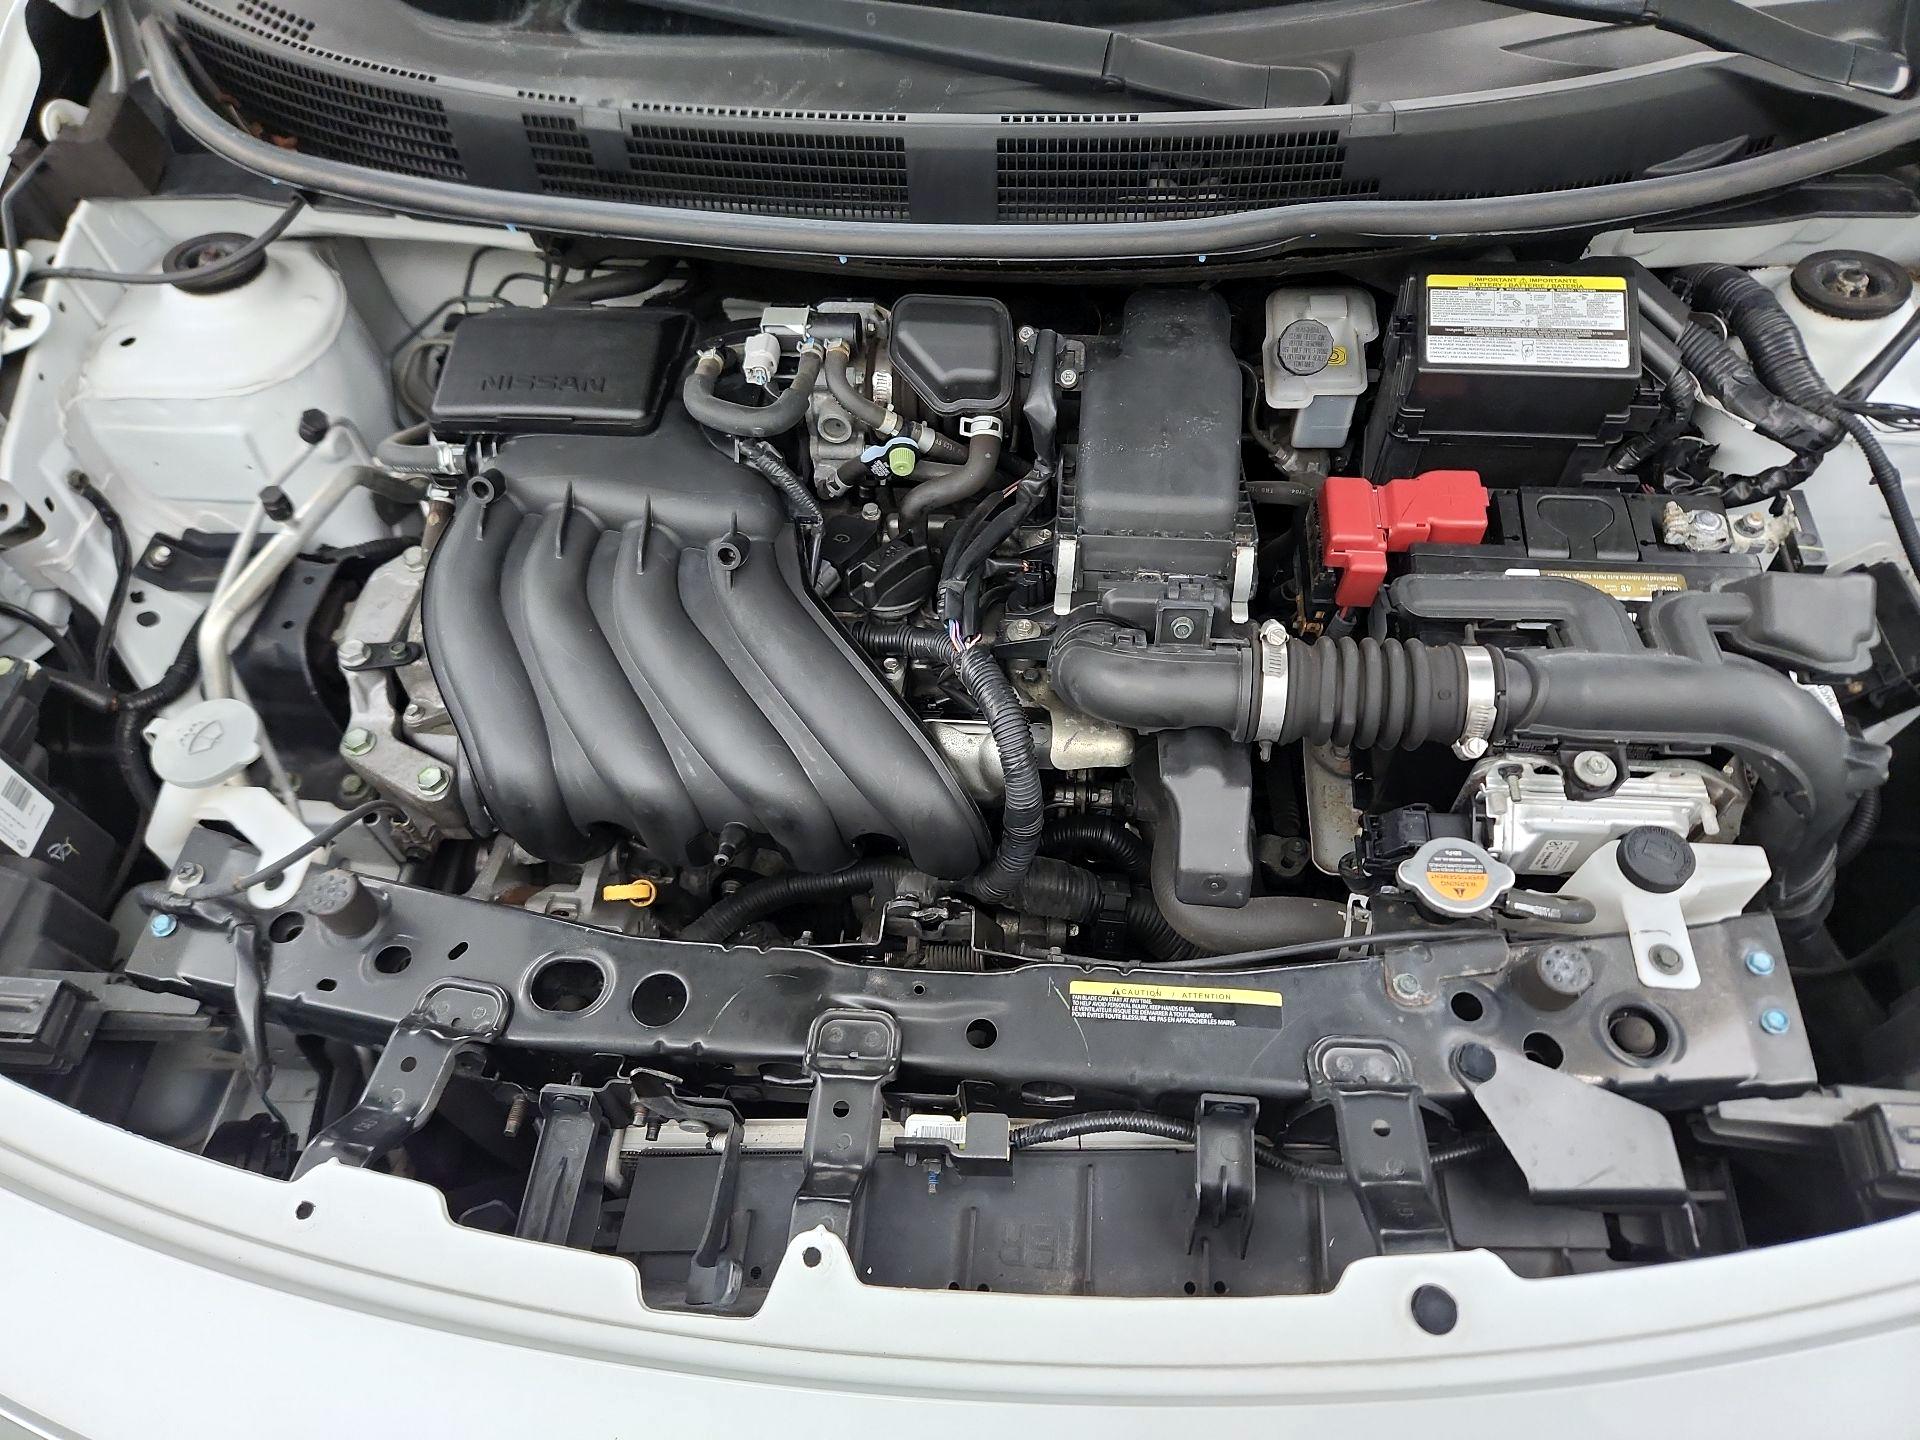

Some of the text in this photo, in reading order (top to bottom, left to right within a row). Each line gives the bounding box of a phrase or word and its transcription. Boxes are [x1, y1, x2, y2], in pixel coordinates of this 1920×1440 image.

[480, 373, 607, 393] NISSAN
[1121, 988, 1162, 997] CAUTION
[1181, 992, 1231, 1000] ATTENTION
[1176, 1017, 1207, 1025] APPROCHER
